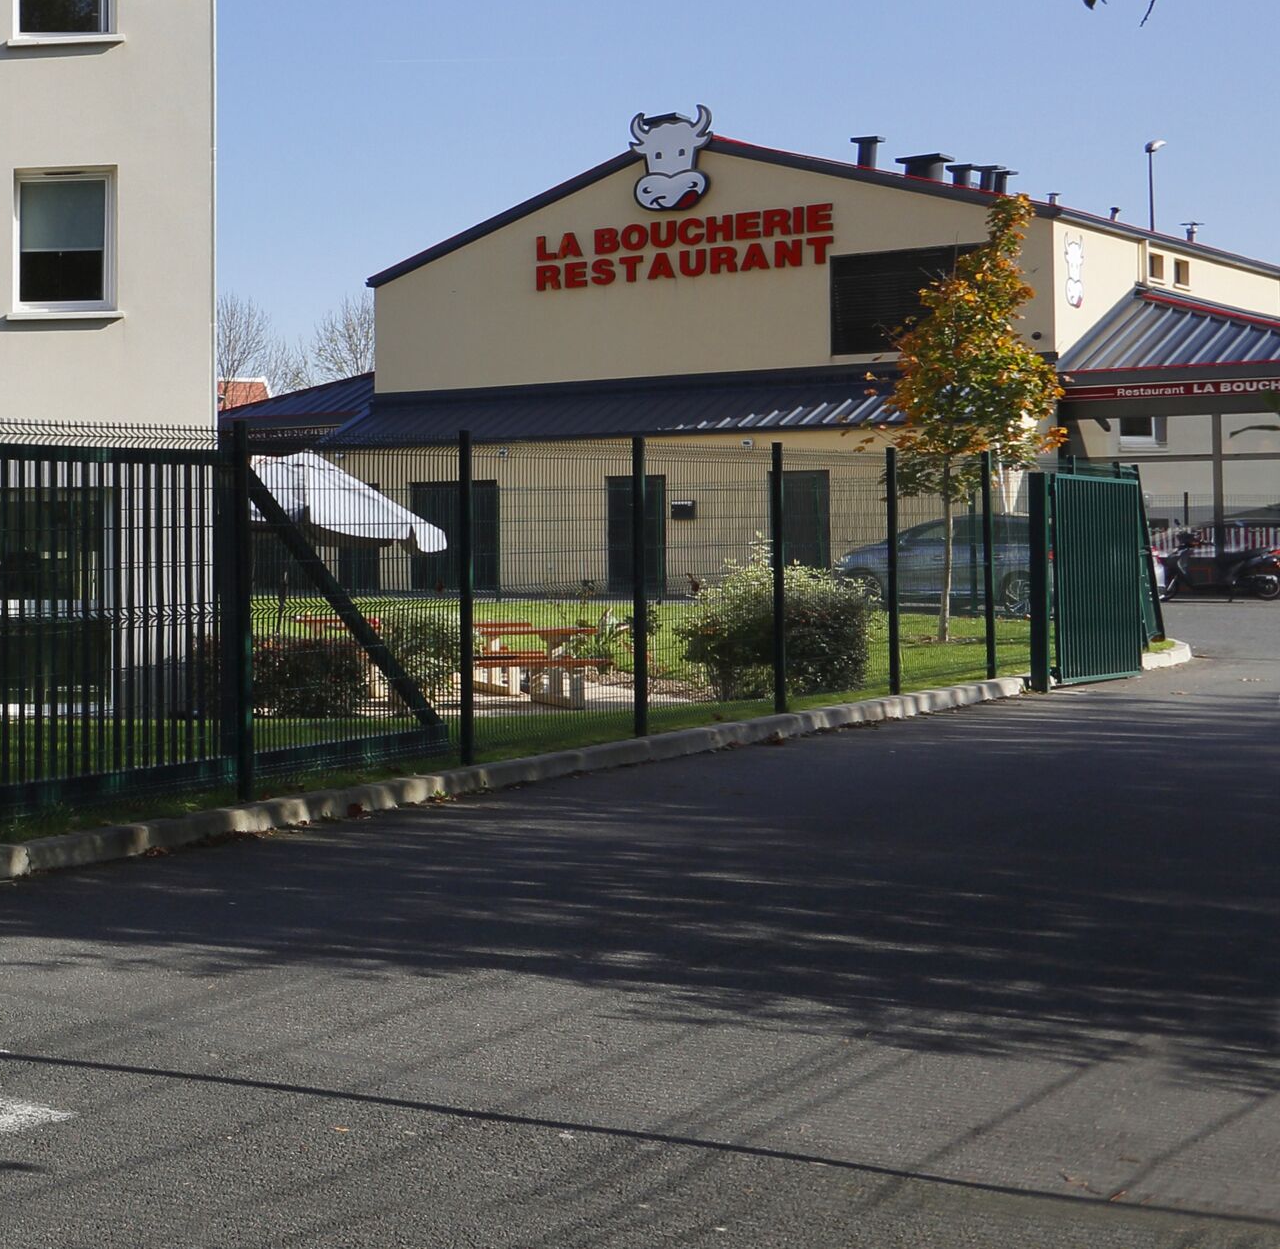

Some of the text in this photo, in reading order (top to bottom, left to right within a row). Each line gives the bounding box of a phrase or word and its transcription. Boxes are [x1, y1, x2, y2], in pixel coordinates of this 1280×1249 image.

[536, 203, 834, 262] LA BOUCHERIE
[536, 236, 834, 292] RESTAURANT
[1117, 387, 1185, 396] Restaurant
[1193, 384, 1215, 393] LA
